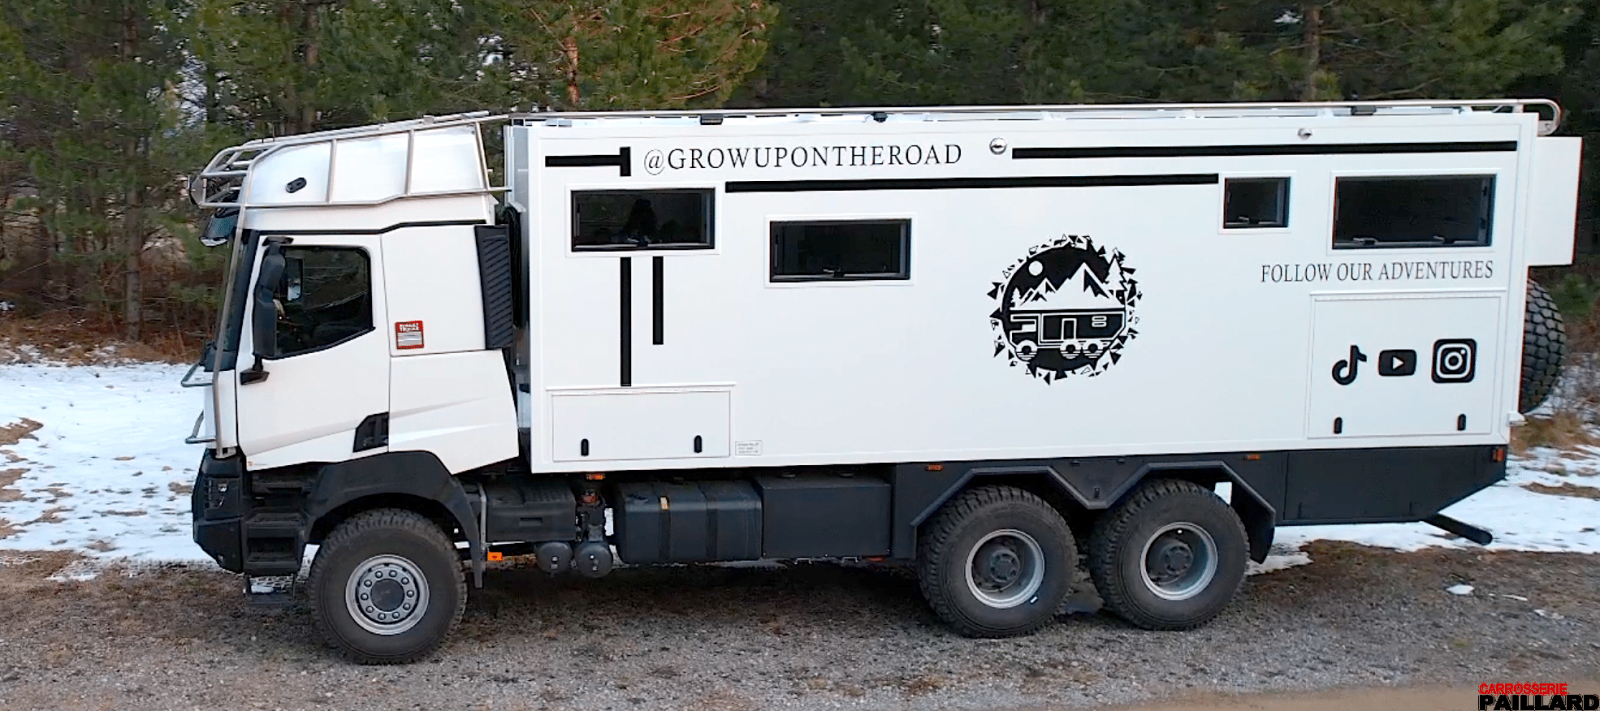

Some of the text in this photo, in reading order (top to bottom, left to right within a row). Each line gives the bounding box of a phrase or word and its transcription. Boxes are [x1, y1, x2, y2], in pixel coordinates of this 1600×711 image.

[644, 144, 962, 175] @GROWUPONTHEROAD
[1261, 260, 1494, 283] FOLLOW OUR ADVENTURES
